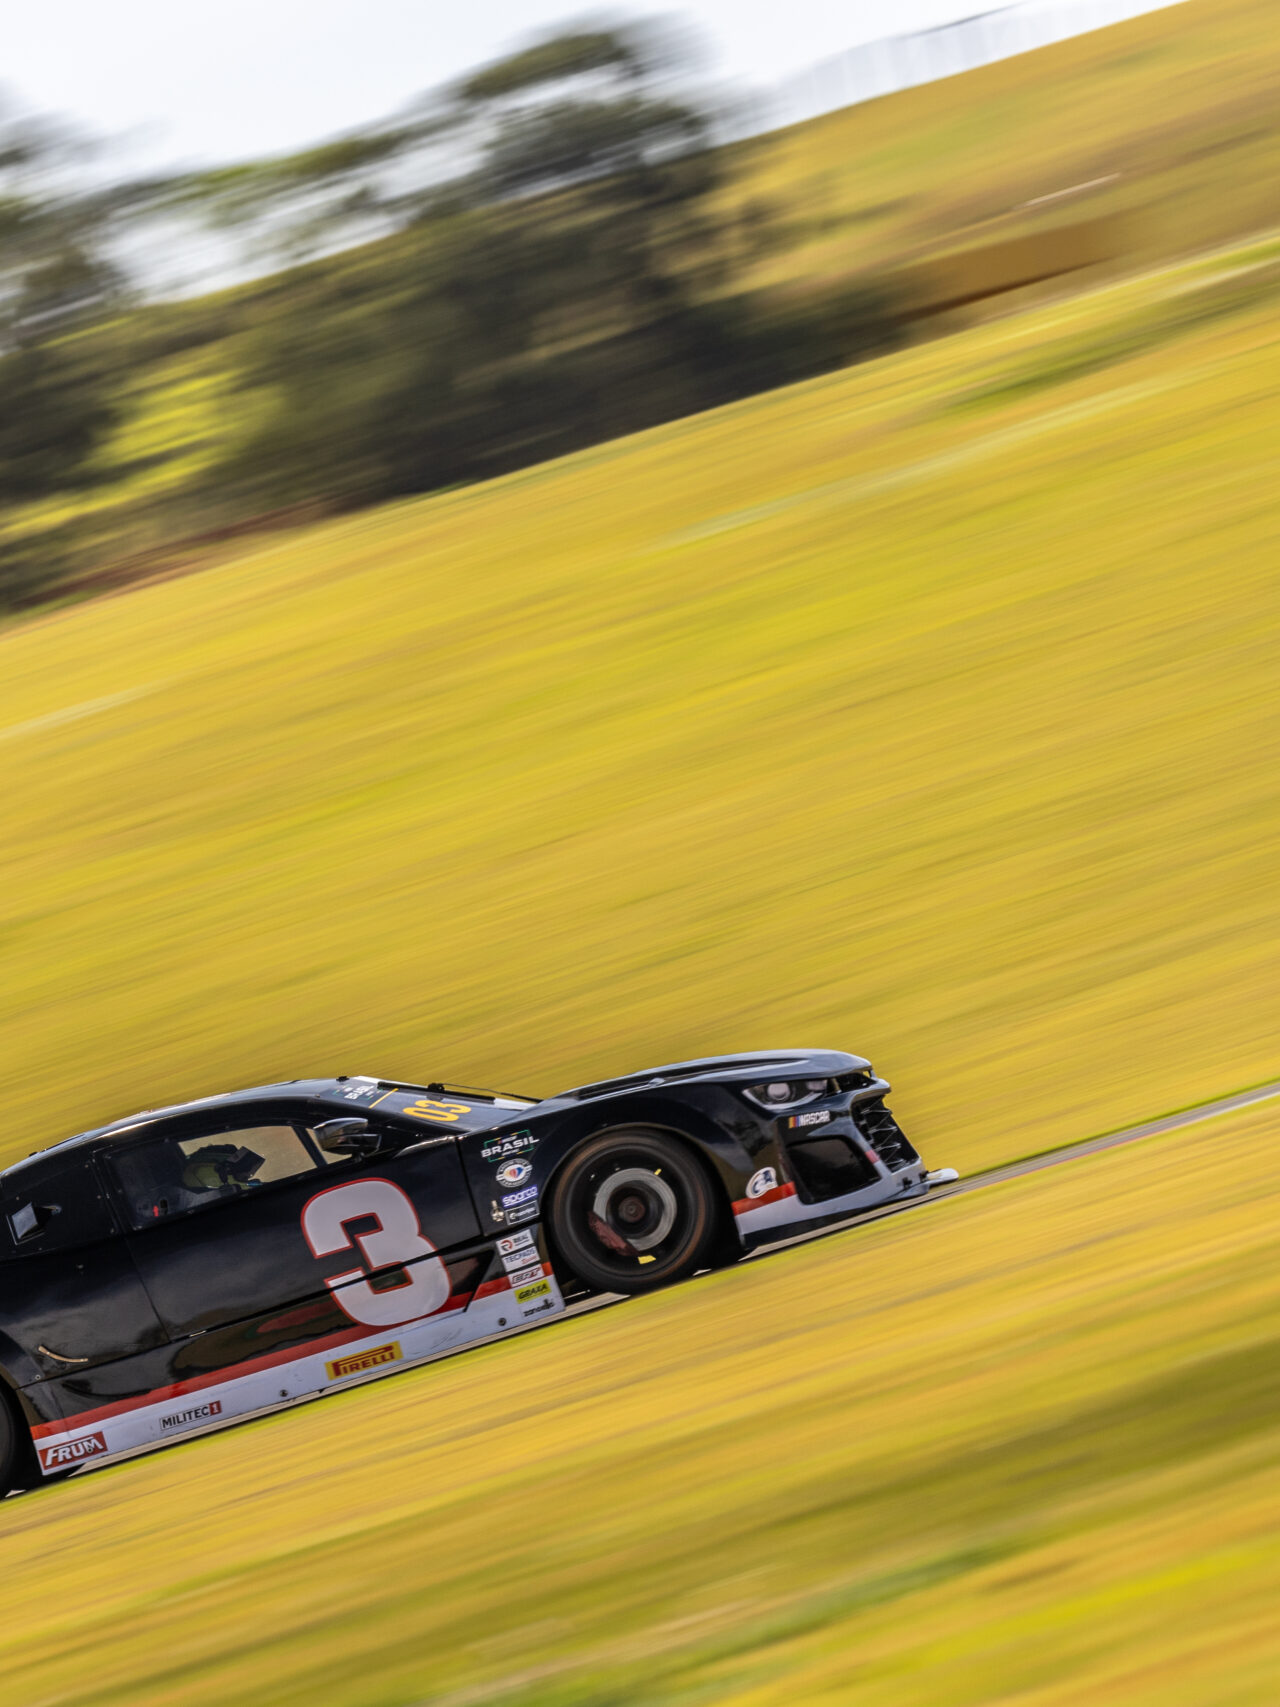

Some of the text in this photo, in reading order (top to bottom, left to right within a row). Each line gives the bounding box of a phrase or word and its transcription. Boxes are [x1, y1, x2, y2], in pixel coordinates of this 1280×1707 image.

[402, 1099, 471, 1122] 03
[481, 1135, 540, 1158] BRASIL
[502, 1186, 538, 1206] sparco
[301, 1177, 452, 1327] 3
[332, 1345, 396, 1377] PIRELLI
[45, 1435, 104, 1467] FRUM
